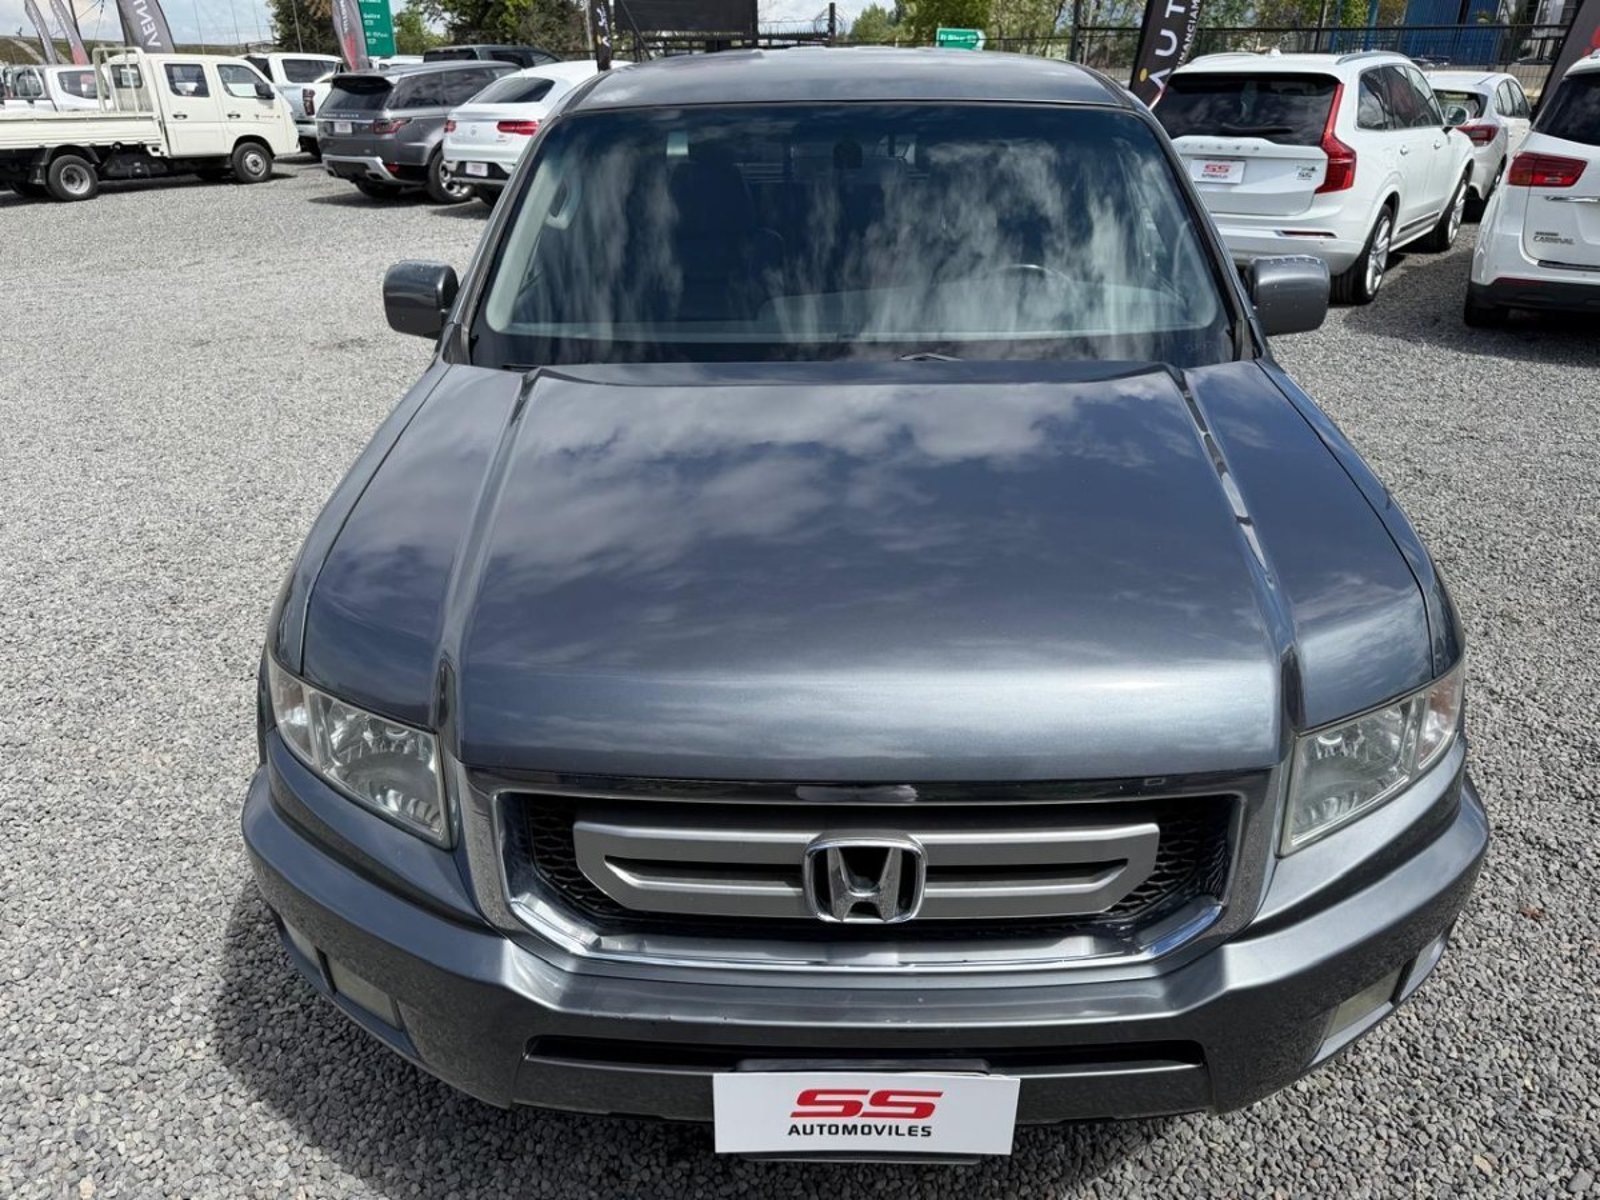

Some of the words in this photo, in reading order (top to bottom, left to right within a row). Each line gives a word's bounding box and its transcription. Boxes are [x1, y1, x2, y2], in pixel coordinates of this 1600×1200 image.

[1204, 163, 1231, 173] SS
[790, 1089, 943, 1119] SS
[788, 1124, 932, 1137] AUTOMOVILES
